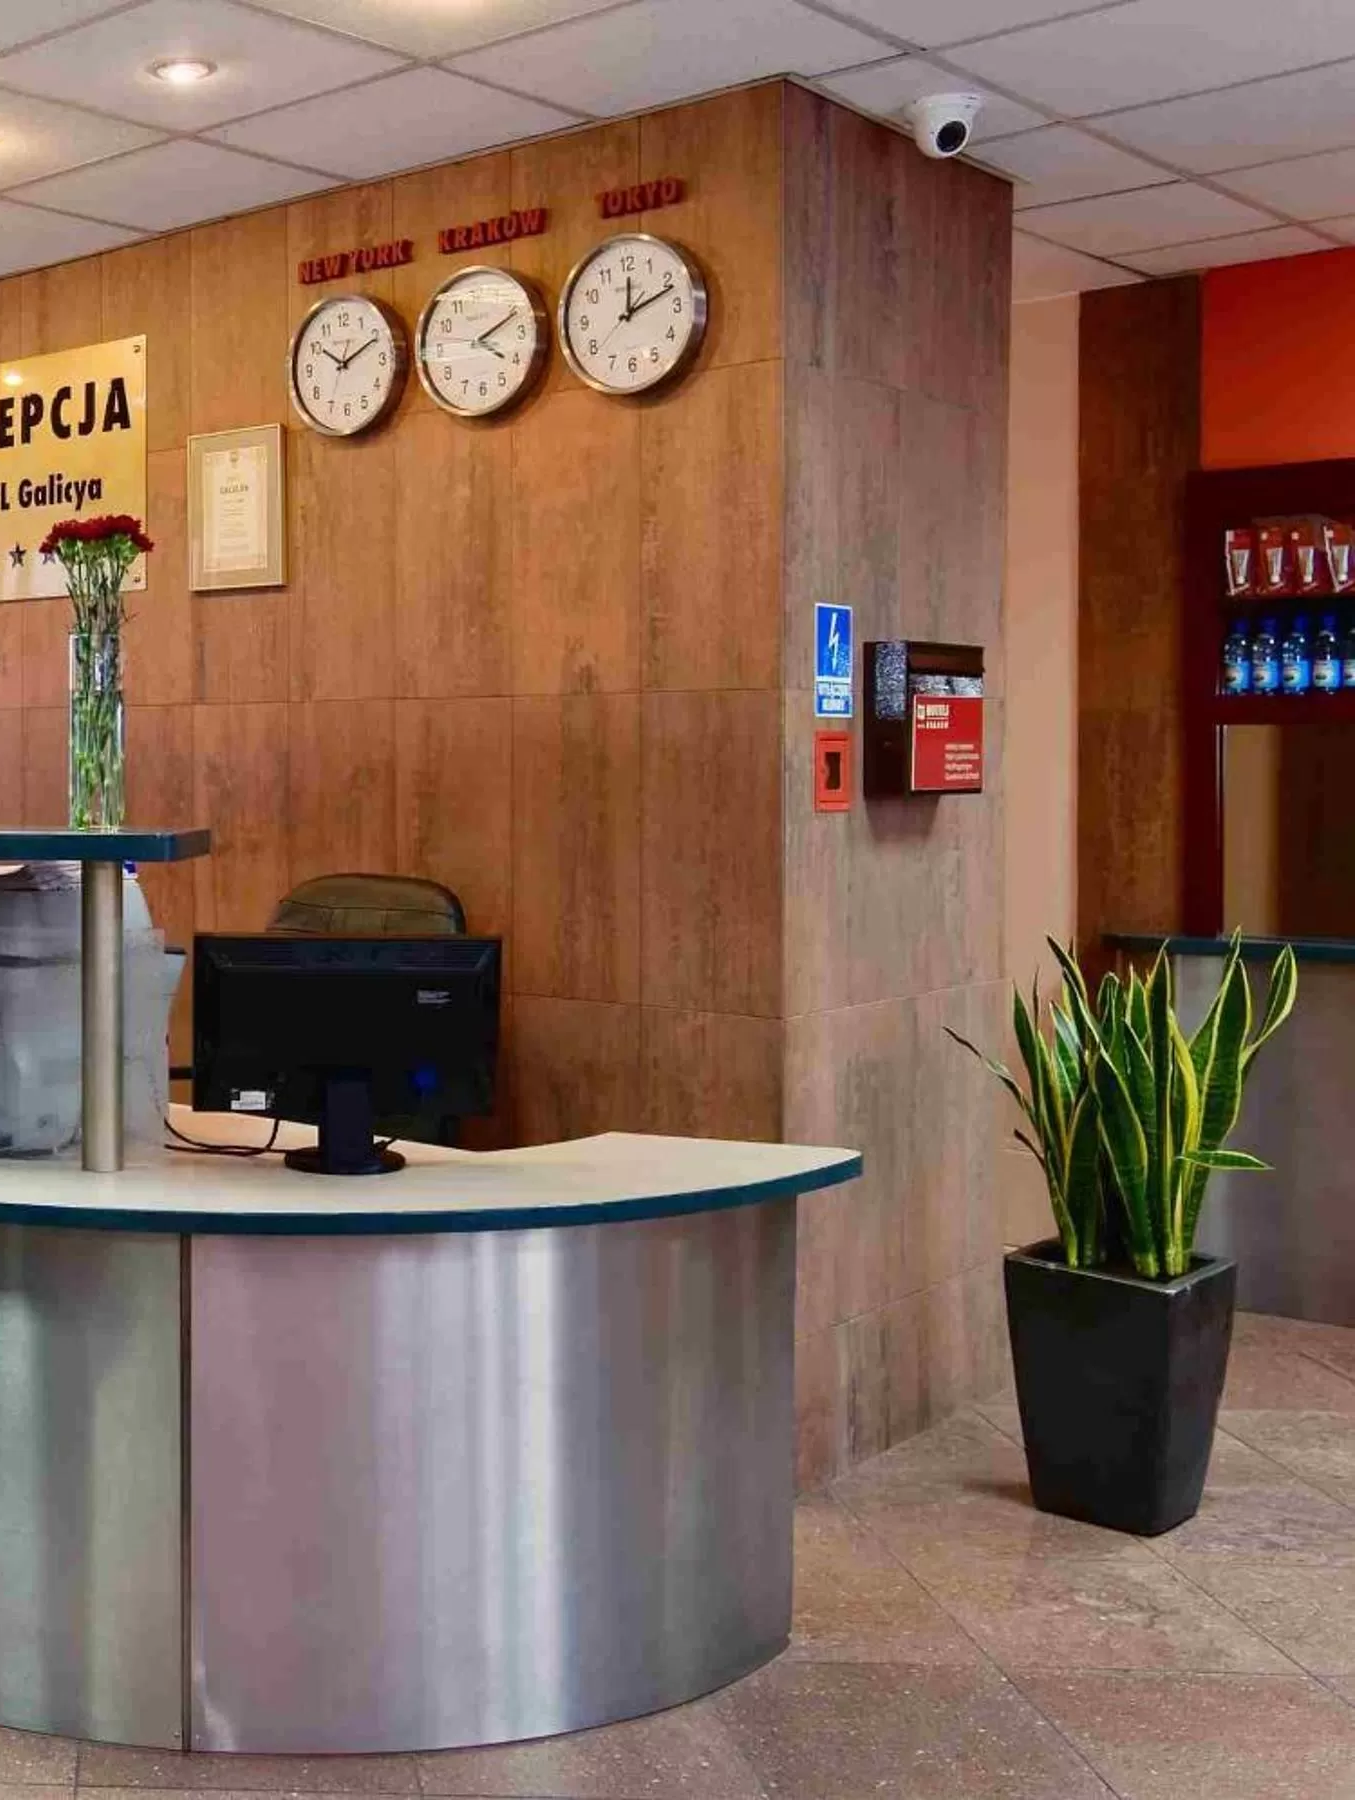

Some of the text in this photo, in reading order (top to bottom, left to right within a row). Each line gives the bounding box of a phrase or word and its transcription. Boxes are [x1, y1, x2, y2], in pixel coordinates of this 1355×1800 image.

[298, 239, 414, 284] NEW YORK
[620, 256, 635, 272] 12
[599, 268, 611, 284] 11
[663, 272, 673, 288] 2
[585, 289, 599, 304] 10
[452, 300, 463, 314] 11
[672, 297, 682, 314] 3
[337, 313, 349, 328] 12
[440, 318, 452, 333] 10
[580, 315, 589, 331] 9
[322, 324, 331, 337] 11
[517, 325, 526, 340] 3
[665, 325, 675, 342] 4
[589, 339, 599, 355] 8
[378, 351, 387, 366] 3
[512, 352, 520, 366] 4
[607, 355, 616, 370] 7
[649, 347, 659, 363] 5
[306, 364, 313, 378] 9
[627, 357, 637, 373] 6
[373, 377, 381, 391] 4
[460, 379, 469, 394] 7
[497, 372, 506, 387] 5
[479, 382, 487, 397] 6
[327, 400, 335, 413] 7
[344, 402, 351, 417] 6
[360, 395, 369, 409] 5
[18, 473, 103, 513] Galicya
